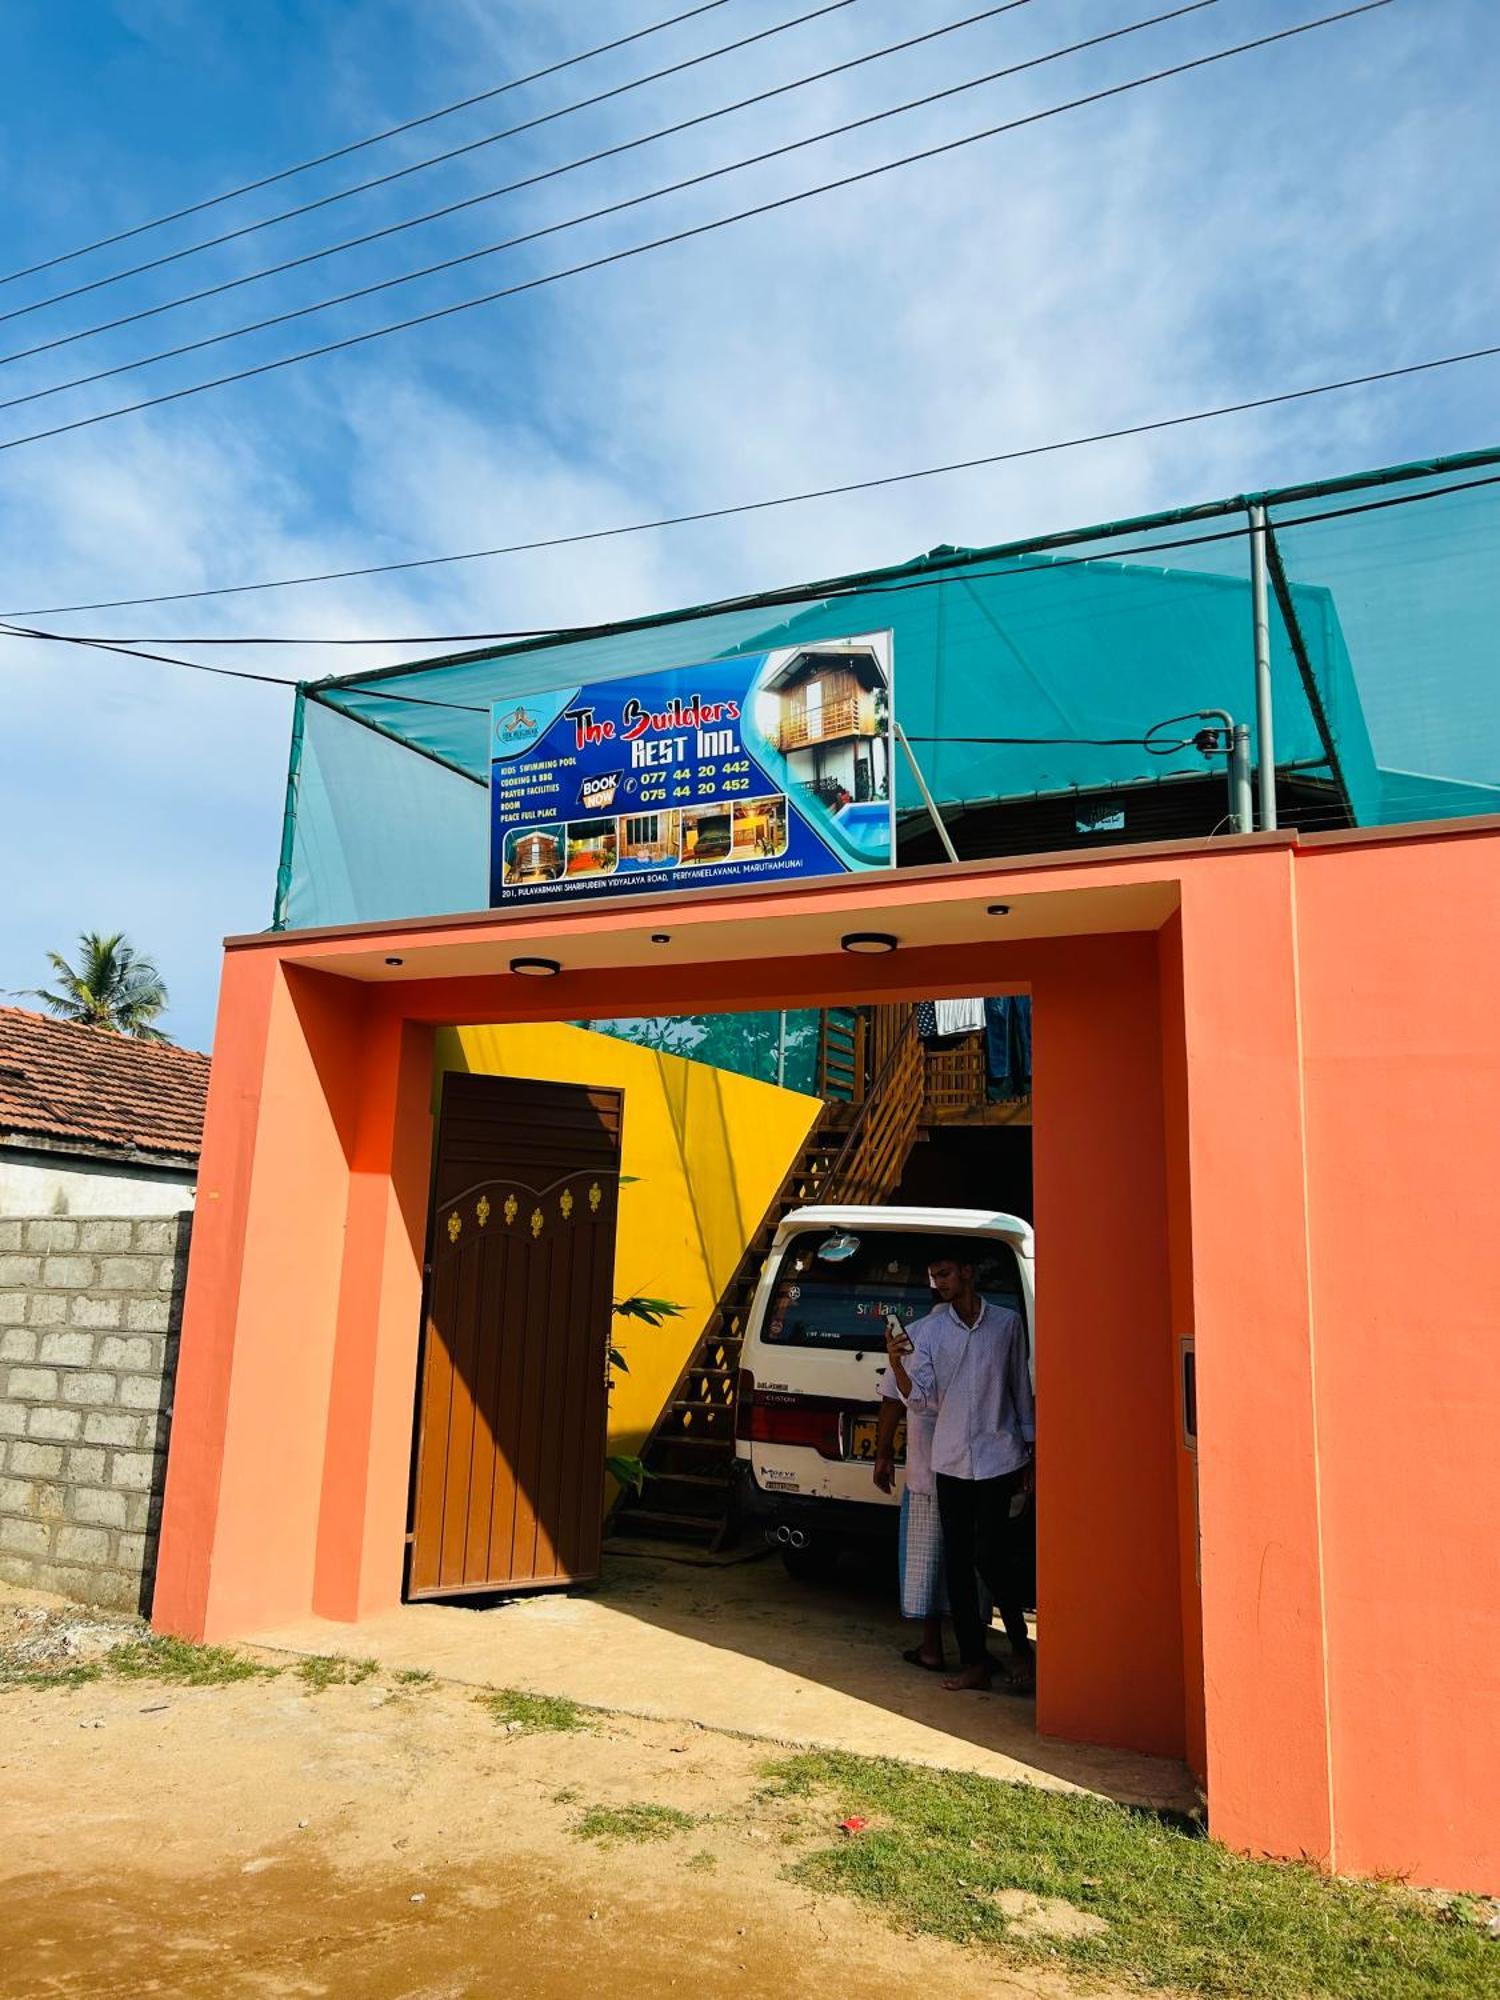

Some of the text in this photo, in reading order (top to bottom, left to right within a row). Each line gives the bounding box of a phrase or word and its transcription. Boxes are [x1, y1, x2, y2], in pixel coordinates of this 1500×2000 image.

[564, 694, 741, 751] The Builders
[631, 736, 688, 769] REST
[500, 756, 577, 776] KIDS SWIMMING POOL
[640, 760, 750, 785] 077 44 20 442
[500, 775, 530, 788] COOKING
[539, 772, 553, 782] BBQ
[583, 774, 617, 796] BOOK
[640, 778, 750, 802] 075 44 20 452
[500, 783, 560, 799] PRAYER FACILITIES
[583, 788, 615, 808] NOW
[500, 800, 521, 811] ROOM
[500, 807, 557, 823] PEACE FULL PLACE
[608, 874, 645, 886] VIDYALAYA
